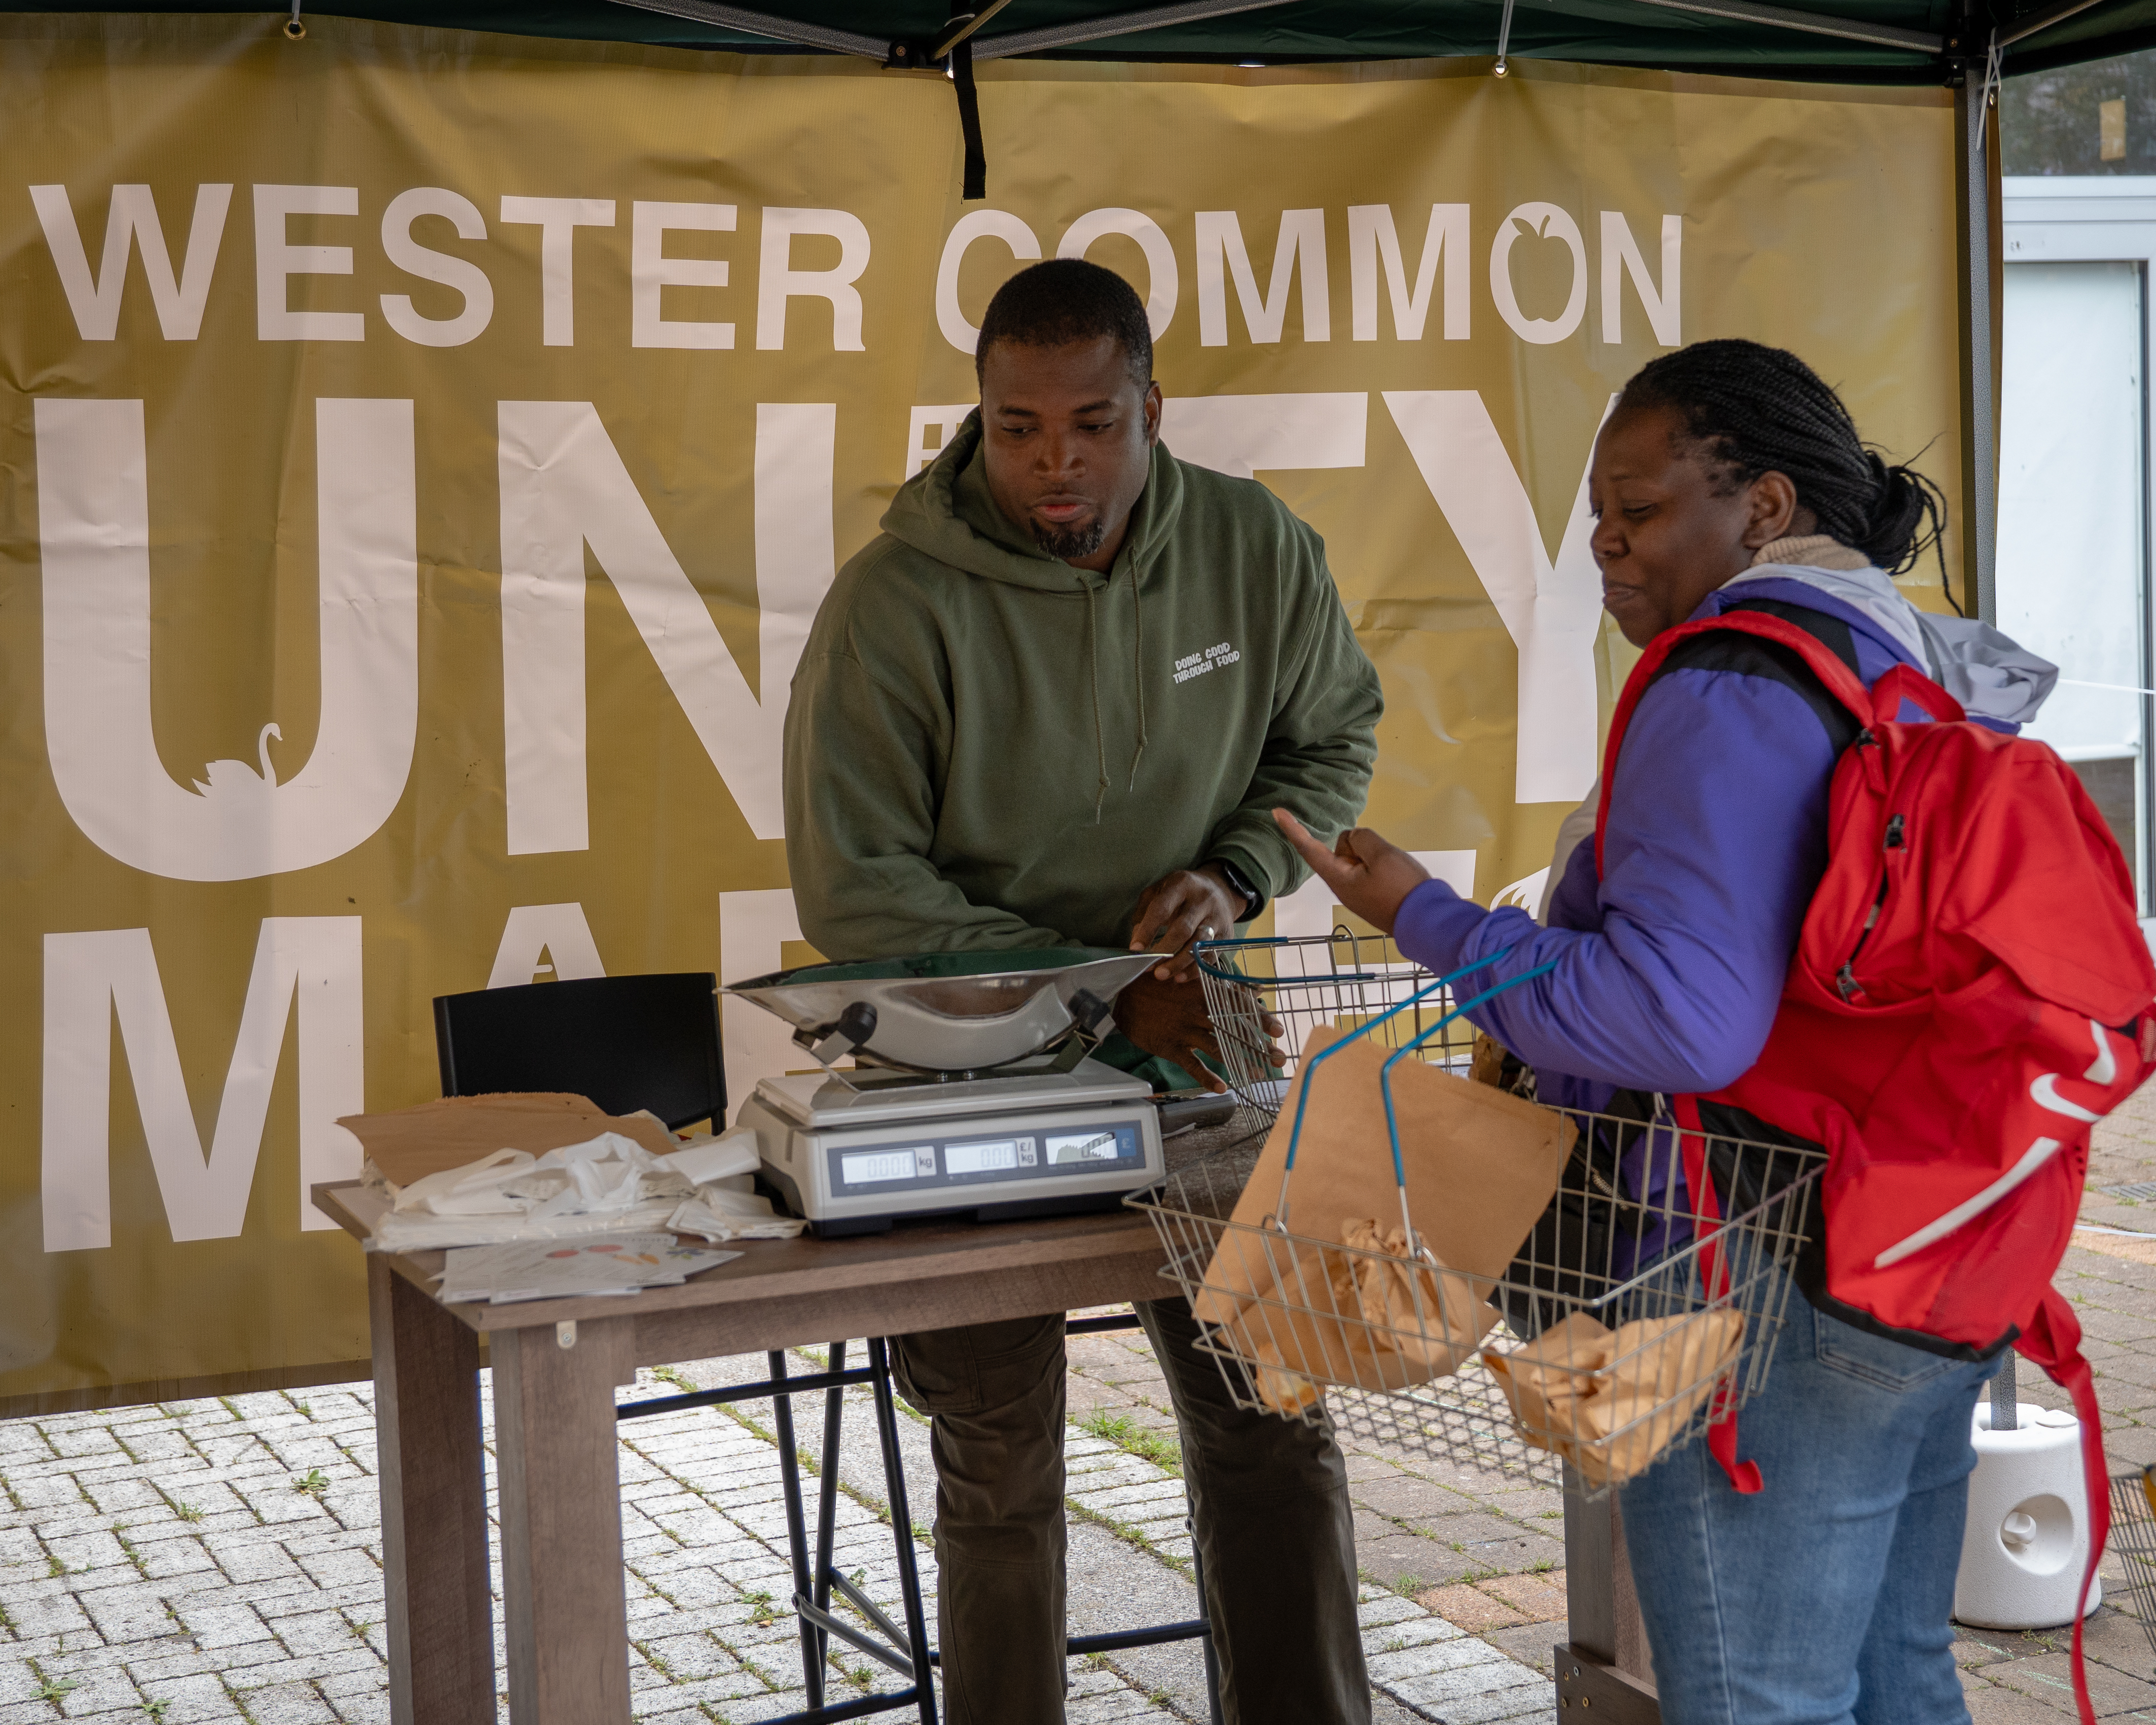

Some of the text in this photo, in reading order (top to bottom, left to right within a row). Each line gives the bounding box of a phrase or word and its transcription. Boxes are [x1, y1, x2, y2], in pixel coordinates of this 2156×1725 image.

[28, 183, 1683, 354] WESTER COMMON
[1173, 651, 1240, 684] THROUGH FOOD
[1175, 642, 1230, 671] DOING GOOD
[918, 1156, 933, 1169] kg
[1020, 1153, 1034, 1164] kg
